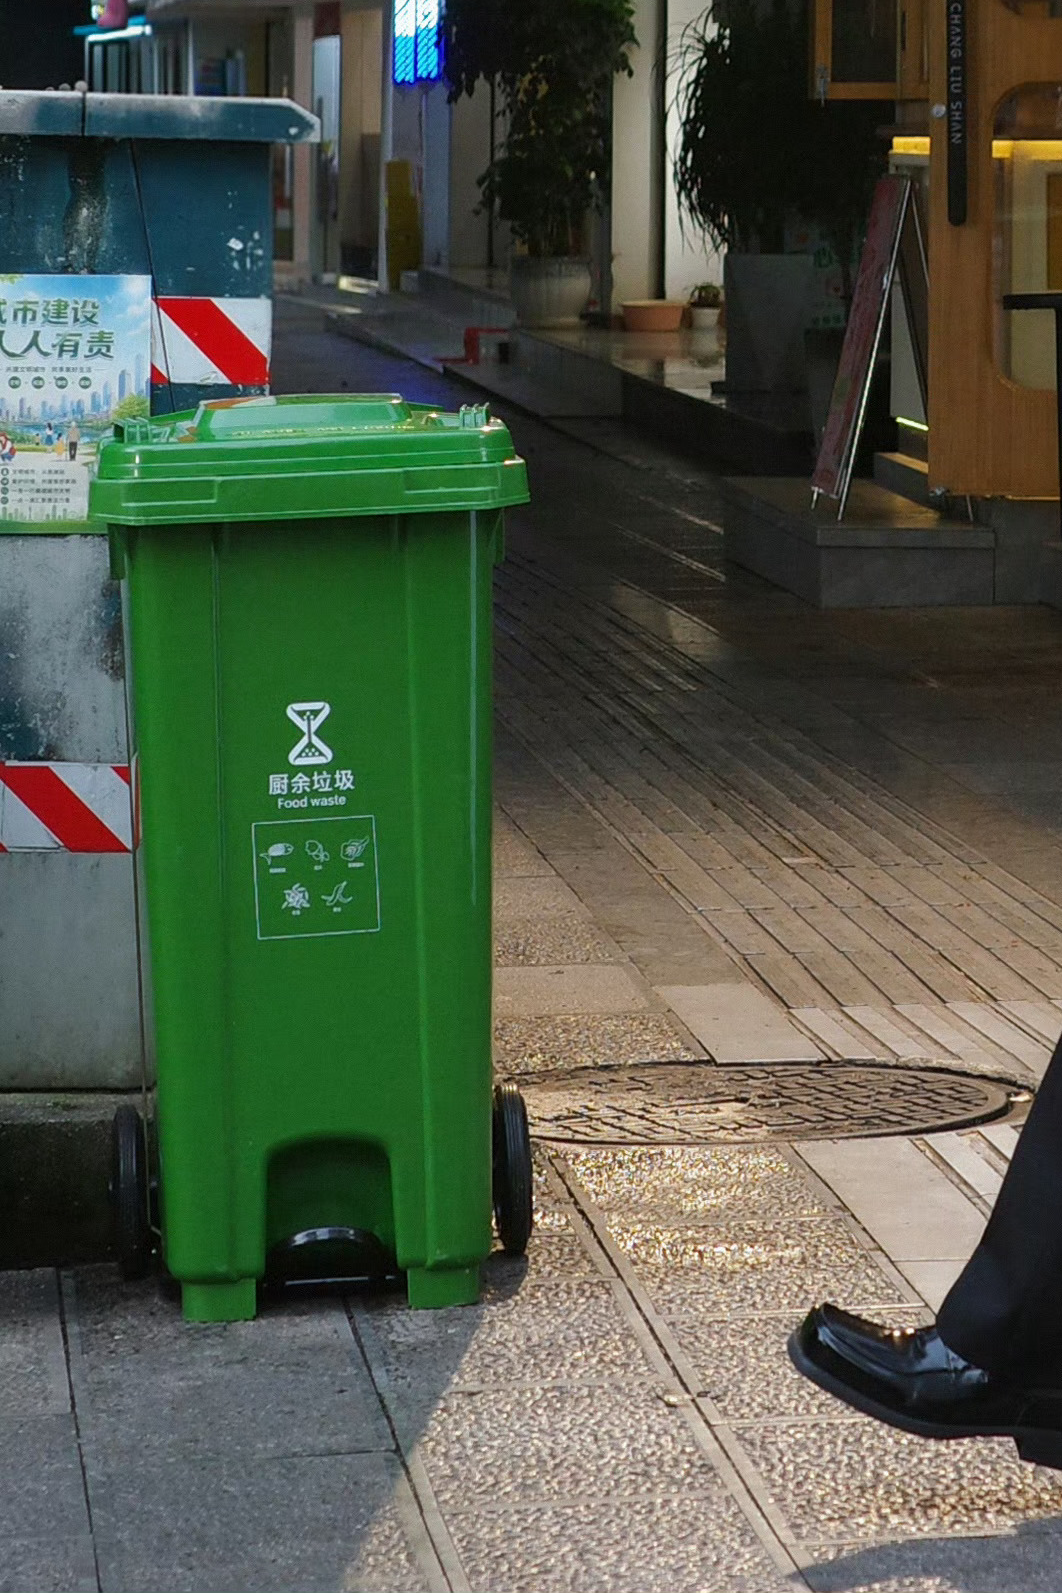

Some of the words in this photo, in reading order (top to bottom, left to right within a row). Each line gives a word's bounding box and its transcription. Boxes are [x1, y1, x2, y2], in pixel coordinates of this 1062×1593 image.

[950, 2, 962, 58] CHANG
[950, 65, 962, 94] LIU
[951, 101, 962, 145] SHAN
[0, 297, 100, 326] 市建设
[268, 769, 355, 795] 厨余垃圾
[277, 796, 308, 809] Food
[310, 795, 347, 807] waste
